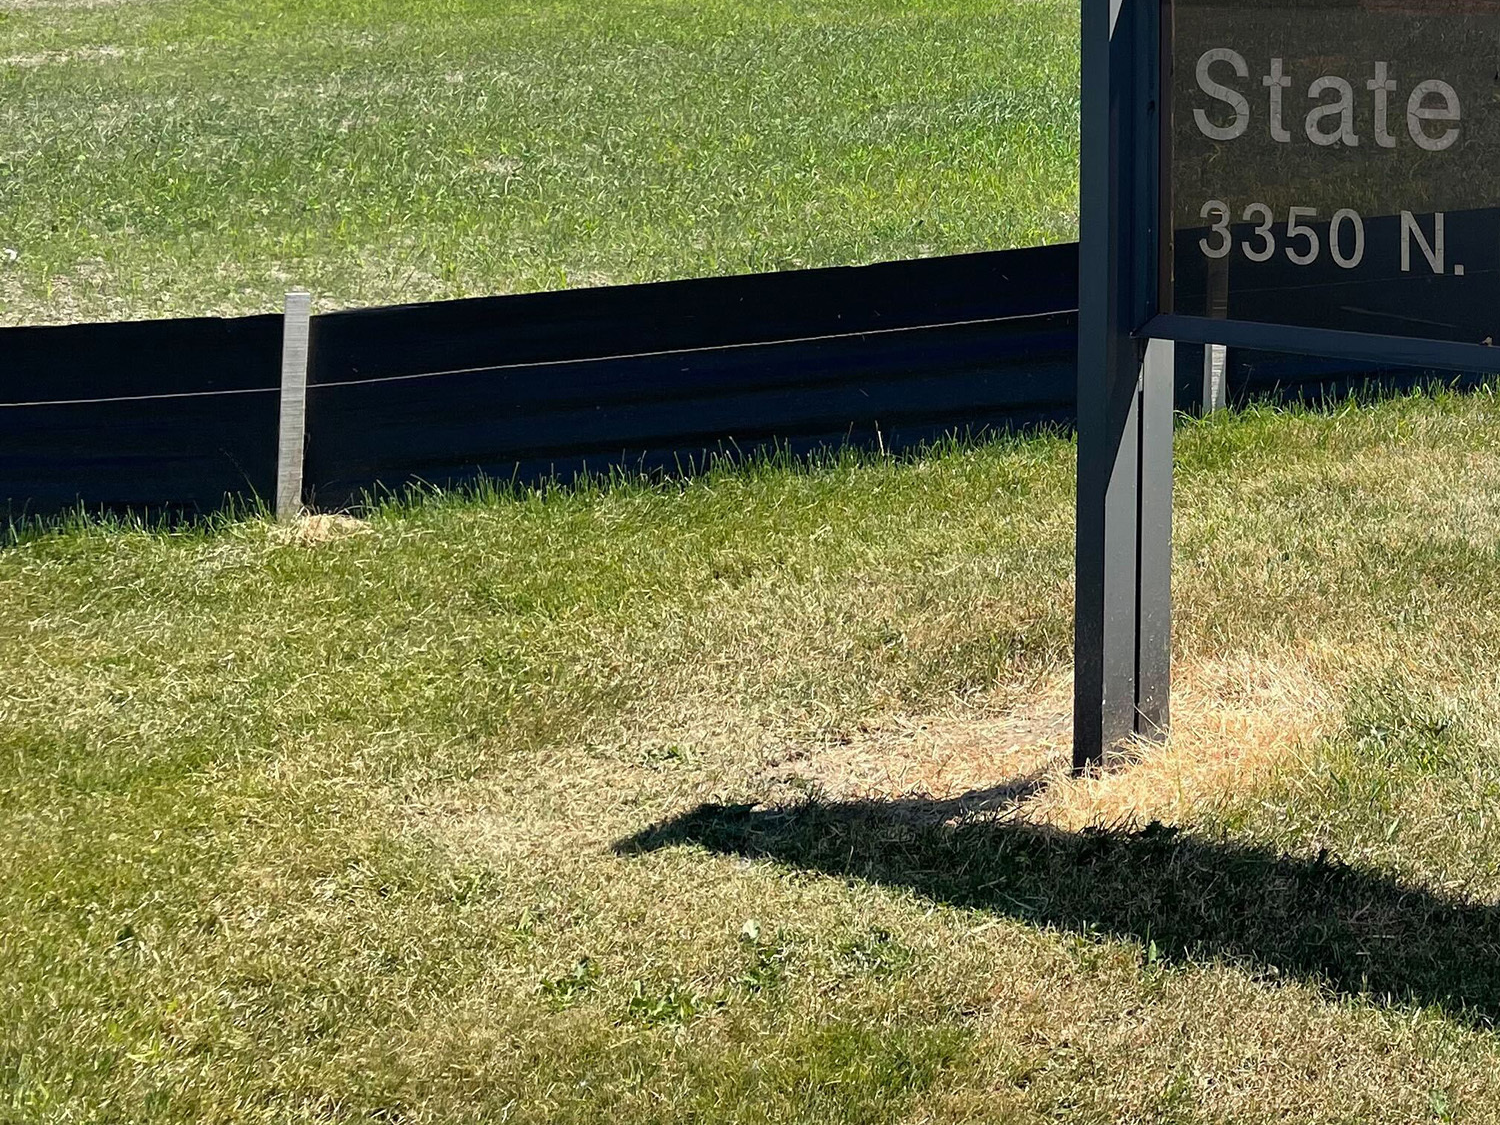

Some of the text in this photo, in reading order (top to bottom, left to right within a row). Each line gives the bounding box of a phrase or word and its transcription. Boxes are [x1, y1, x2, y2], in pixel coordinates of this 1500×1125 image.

[1192, 47, 1462, 152] State
[1198, 199, 1366, 270] 3350
[1399, 210, 1466, 277] N.
